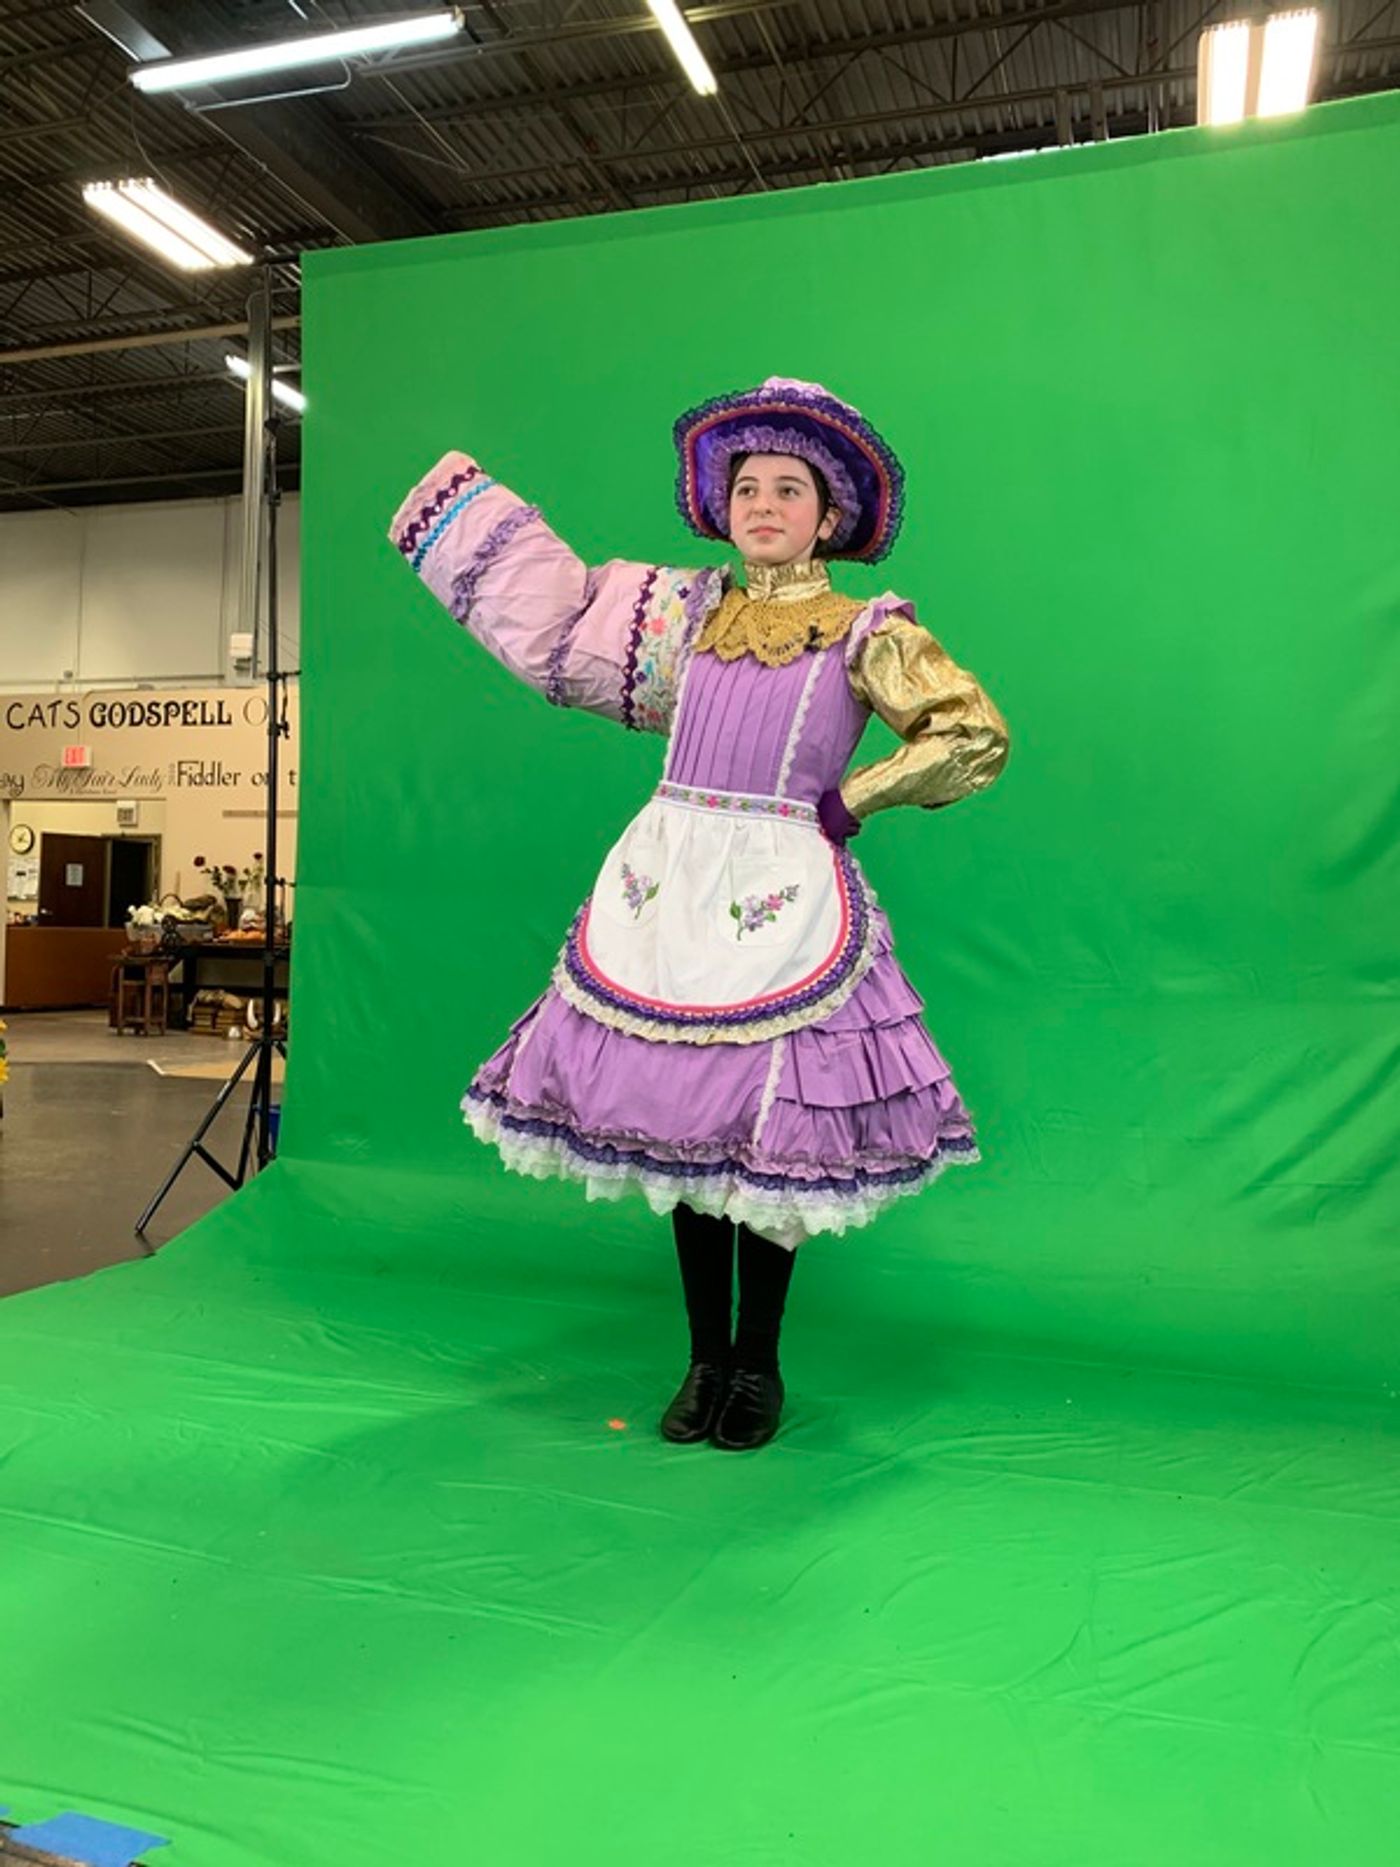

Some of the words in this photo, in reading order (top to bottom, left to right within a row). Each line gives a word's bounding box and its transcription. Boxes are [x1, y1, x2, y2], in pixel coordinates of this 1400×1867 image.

[6, 699, 81, 730] CATS
[89, 699, 233, 729] GODSPELL
[118, 765, 162, 791] Lady
[177, 760, 242, 788] Fiddler
